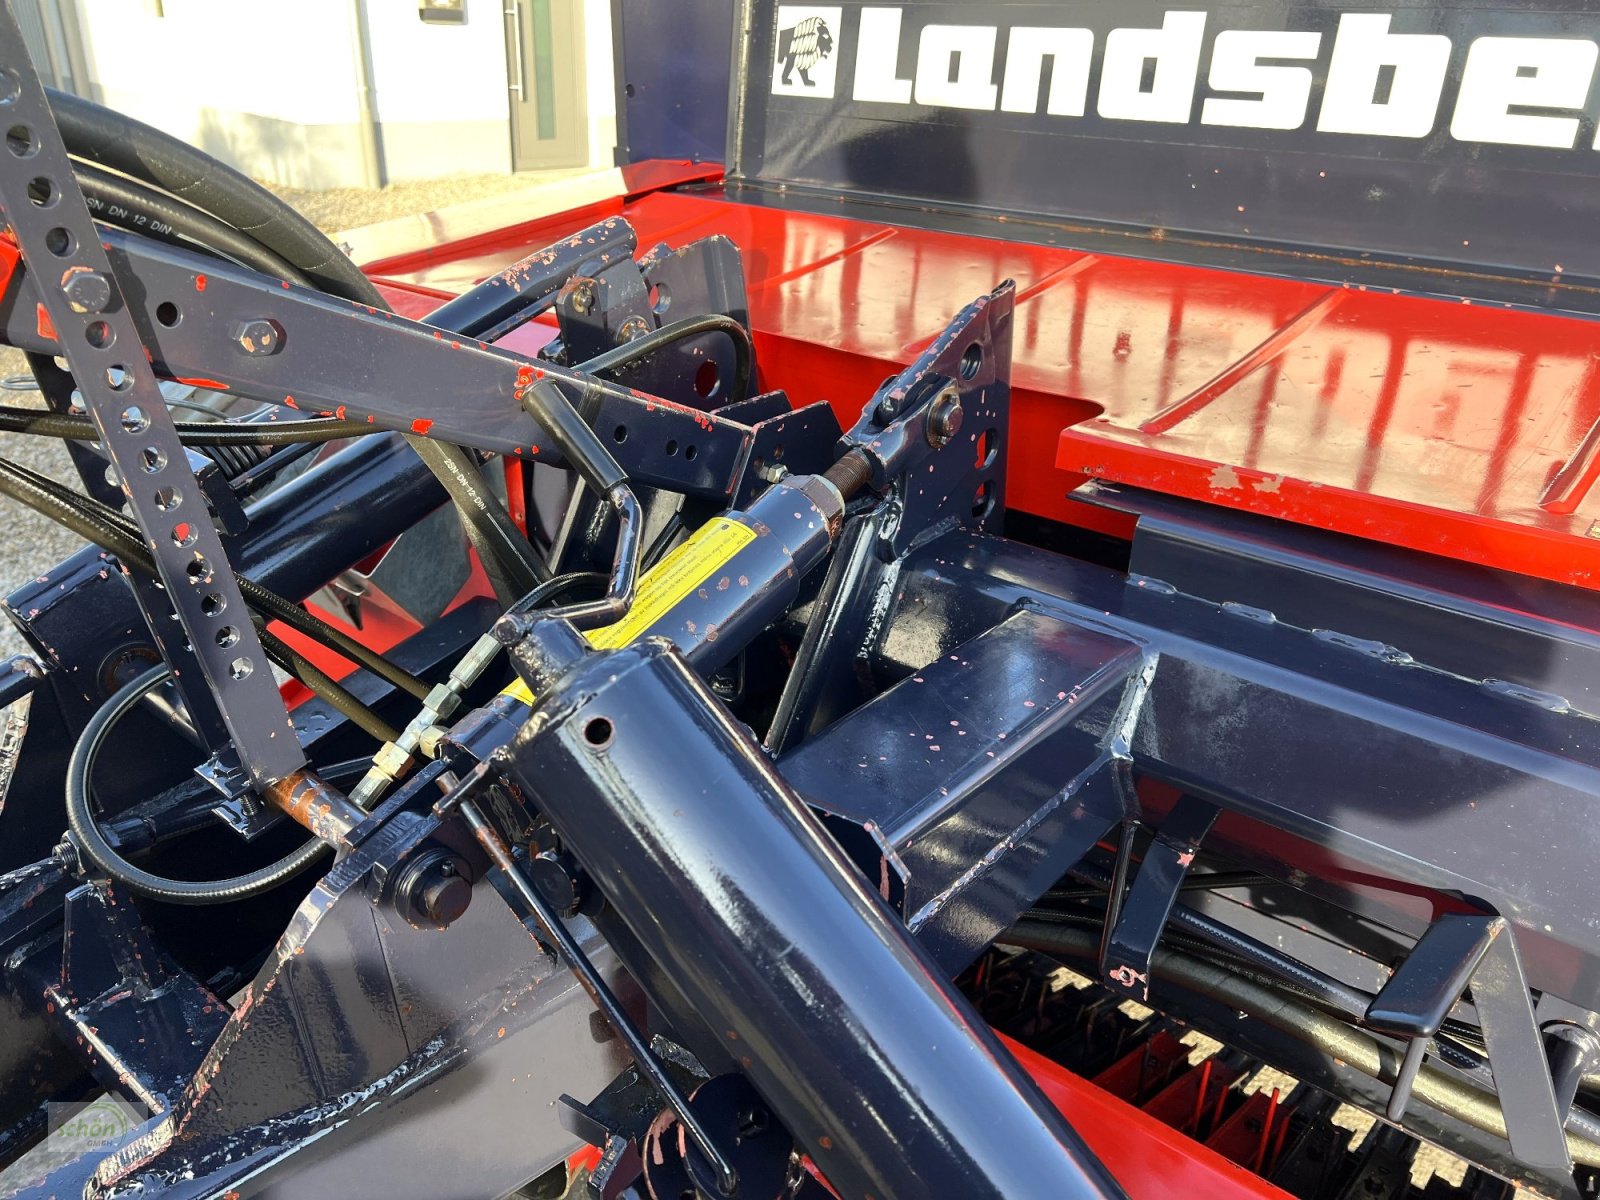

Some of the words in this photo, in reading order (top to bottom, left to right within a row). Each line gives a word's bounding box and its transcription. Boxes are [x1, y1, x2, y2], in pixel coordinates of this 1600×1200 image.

[852, 7, 1600, 151] Landsbe
[108, 205, 128, 218] DN
[133, 214, 146, 226] 12
[150, 220, 172, 235] DIN
[444, 458, 459, 474] 2SN
[456, 474, 469, 487] DN
[466, 486, 476, 497] 12
[473, 496, 487, 511] DIN
